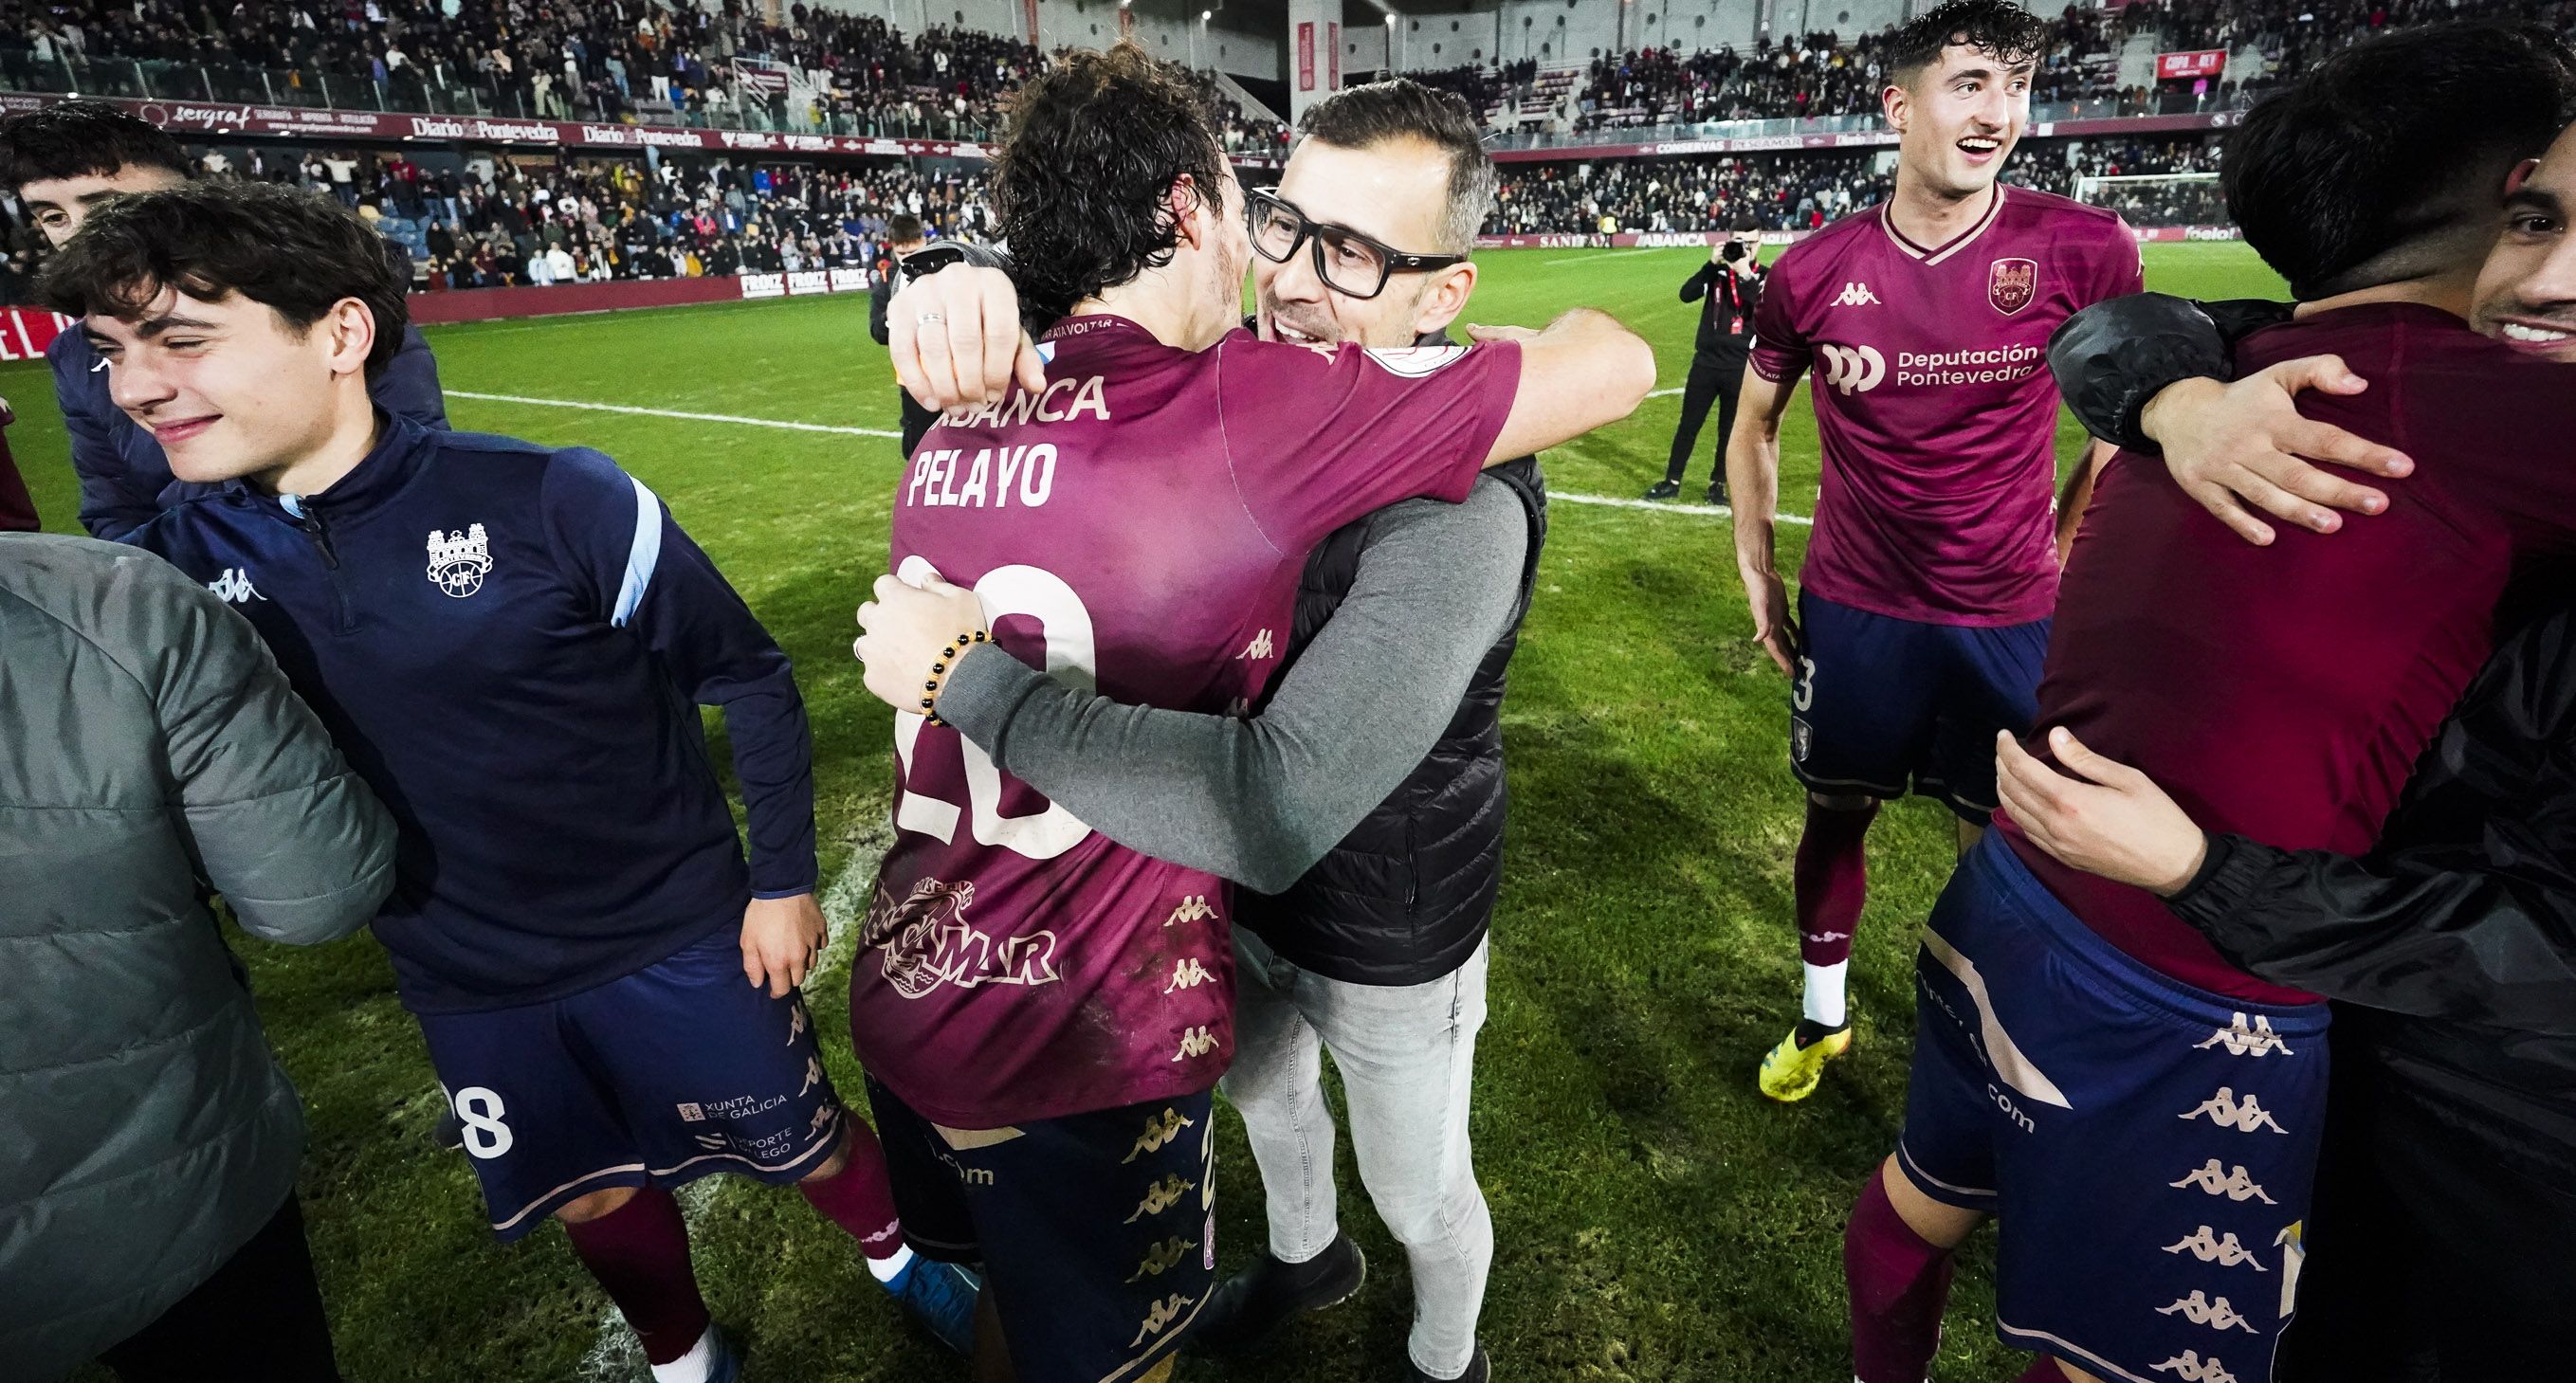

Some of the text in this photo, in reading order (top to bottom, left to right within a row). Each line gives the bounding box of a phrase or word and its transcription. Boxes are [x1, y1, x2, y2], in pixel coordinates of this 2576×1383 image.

[173, 105, 250, 130] sergraf
[411, 117, 463, 137] Diario
[476, 120, 559, 140] Pontevedra
[582, 125, 624, 143] Diario
[635, 129, 703, 147] Pontevedra
[1656, 141, 1725, 155] CONSERVAS
[740, 274, 784, 291] FROIZ
[787, 271, 828, 288] FROIZ
[830, 268, 869, 284] FROIZ
[1898, 343, 2038, 372] Deputación
[1897, 364, 2034, 387] Pontevedra
[906, 443, 1058, 508] PELAYO
[704, 1095, 756, 1112] XUNTA
[730, 1094, 788, 1119] GALICIA
[439, 1080, 514, 1159] 8
[734, 1126, 793, 1149] PORTE
